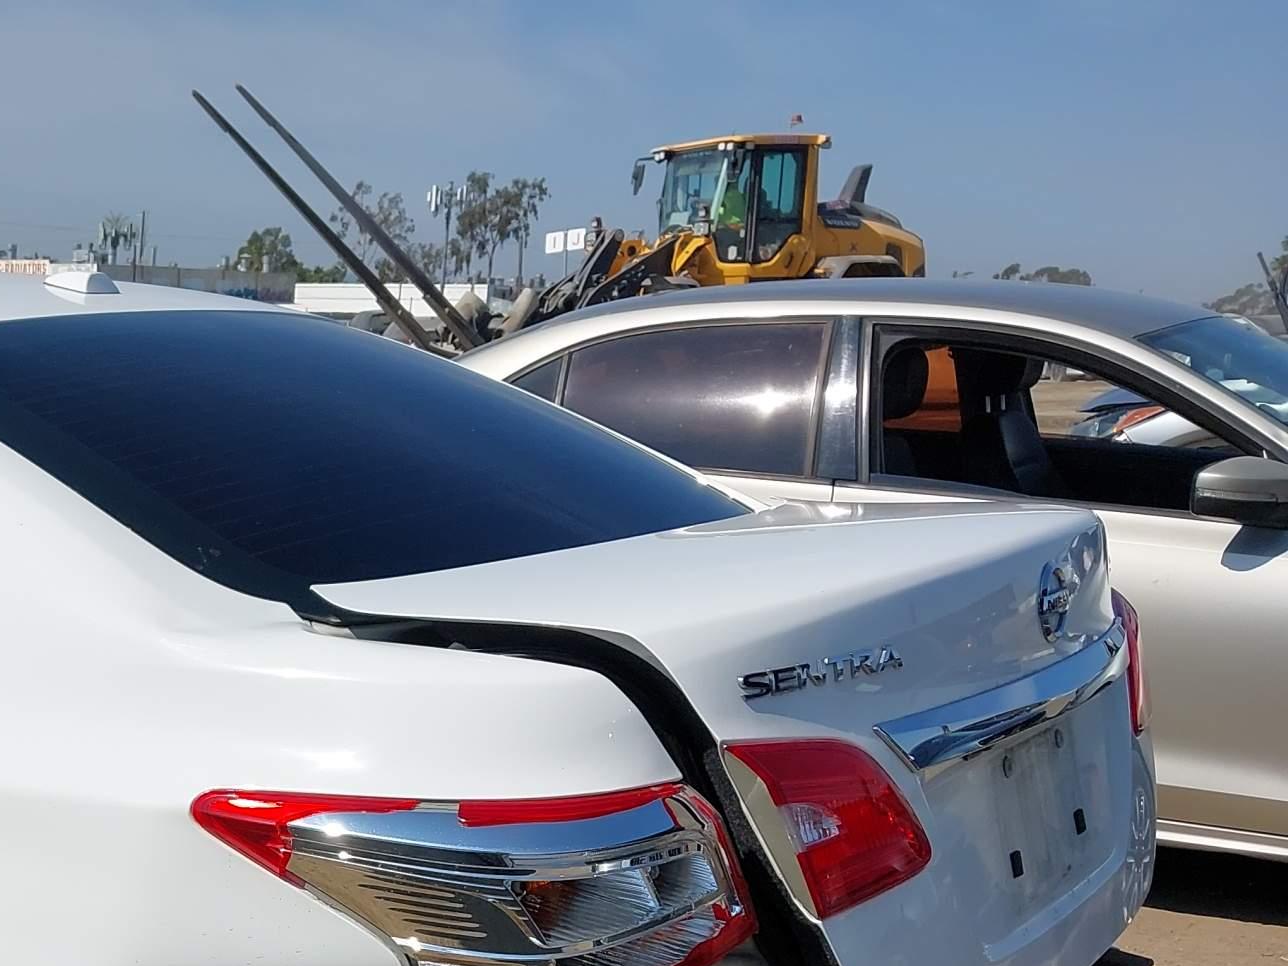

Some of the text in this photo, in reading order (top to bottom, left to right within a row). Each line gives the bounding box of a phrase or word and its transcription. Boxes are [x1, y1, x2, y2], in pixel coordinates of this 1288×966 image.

[572, 232, 580, 246] J
[4, 262, 48, 275] RADIATORS
[738, 644, 904, 700] SENTRA
